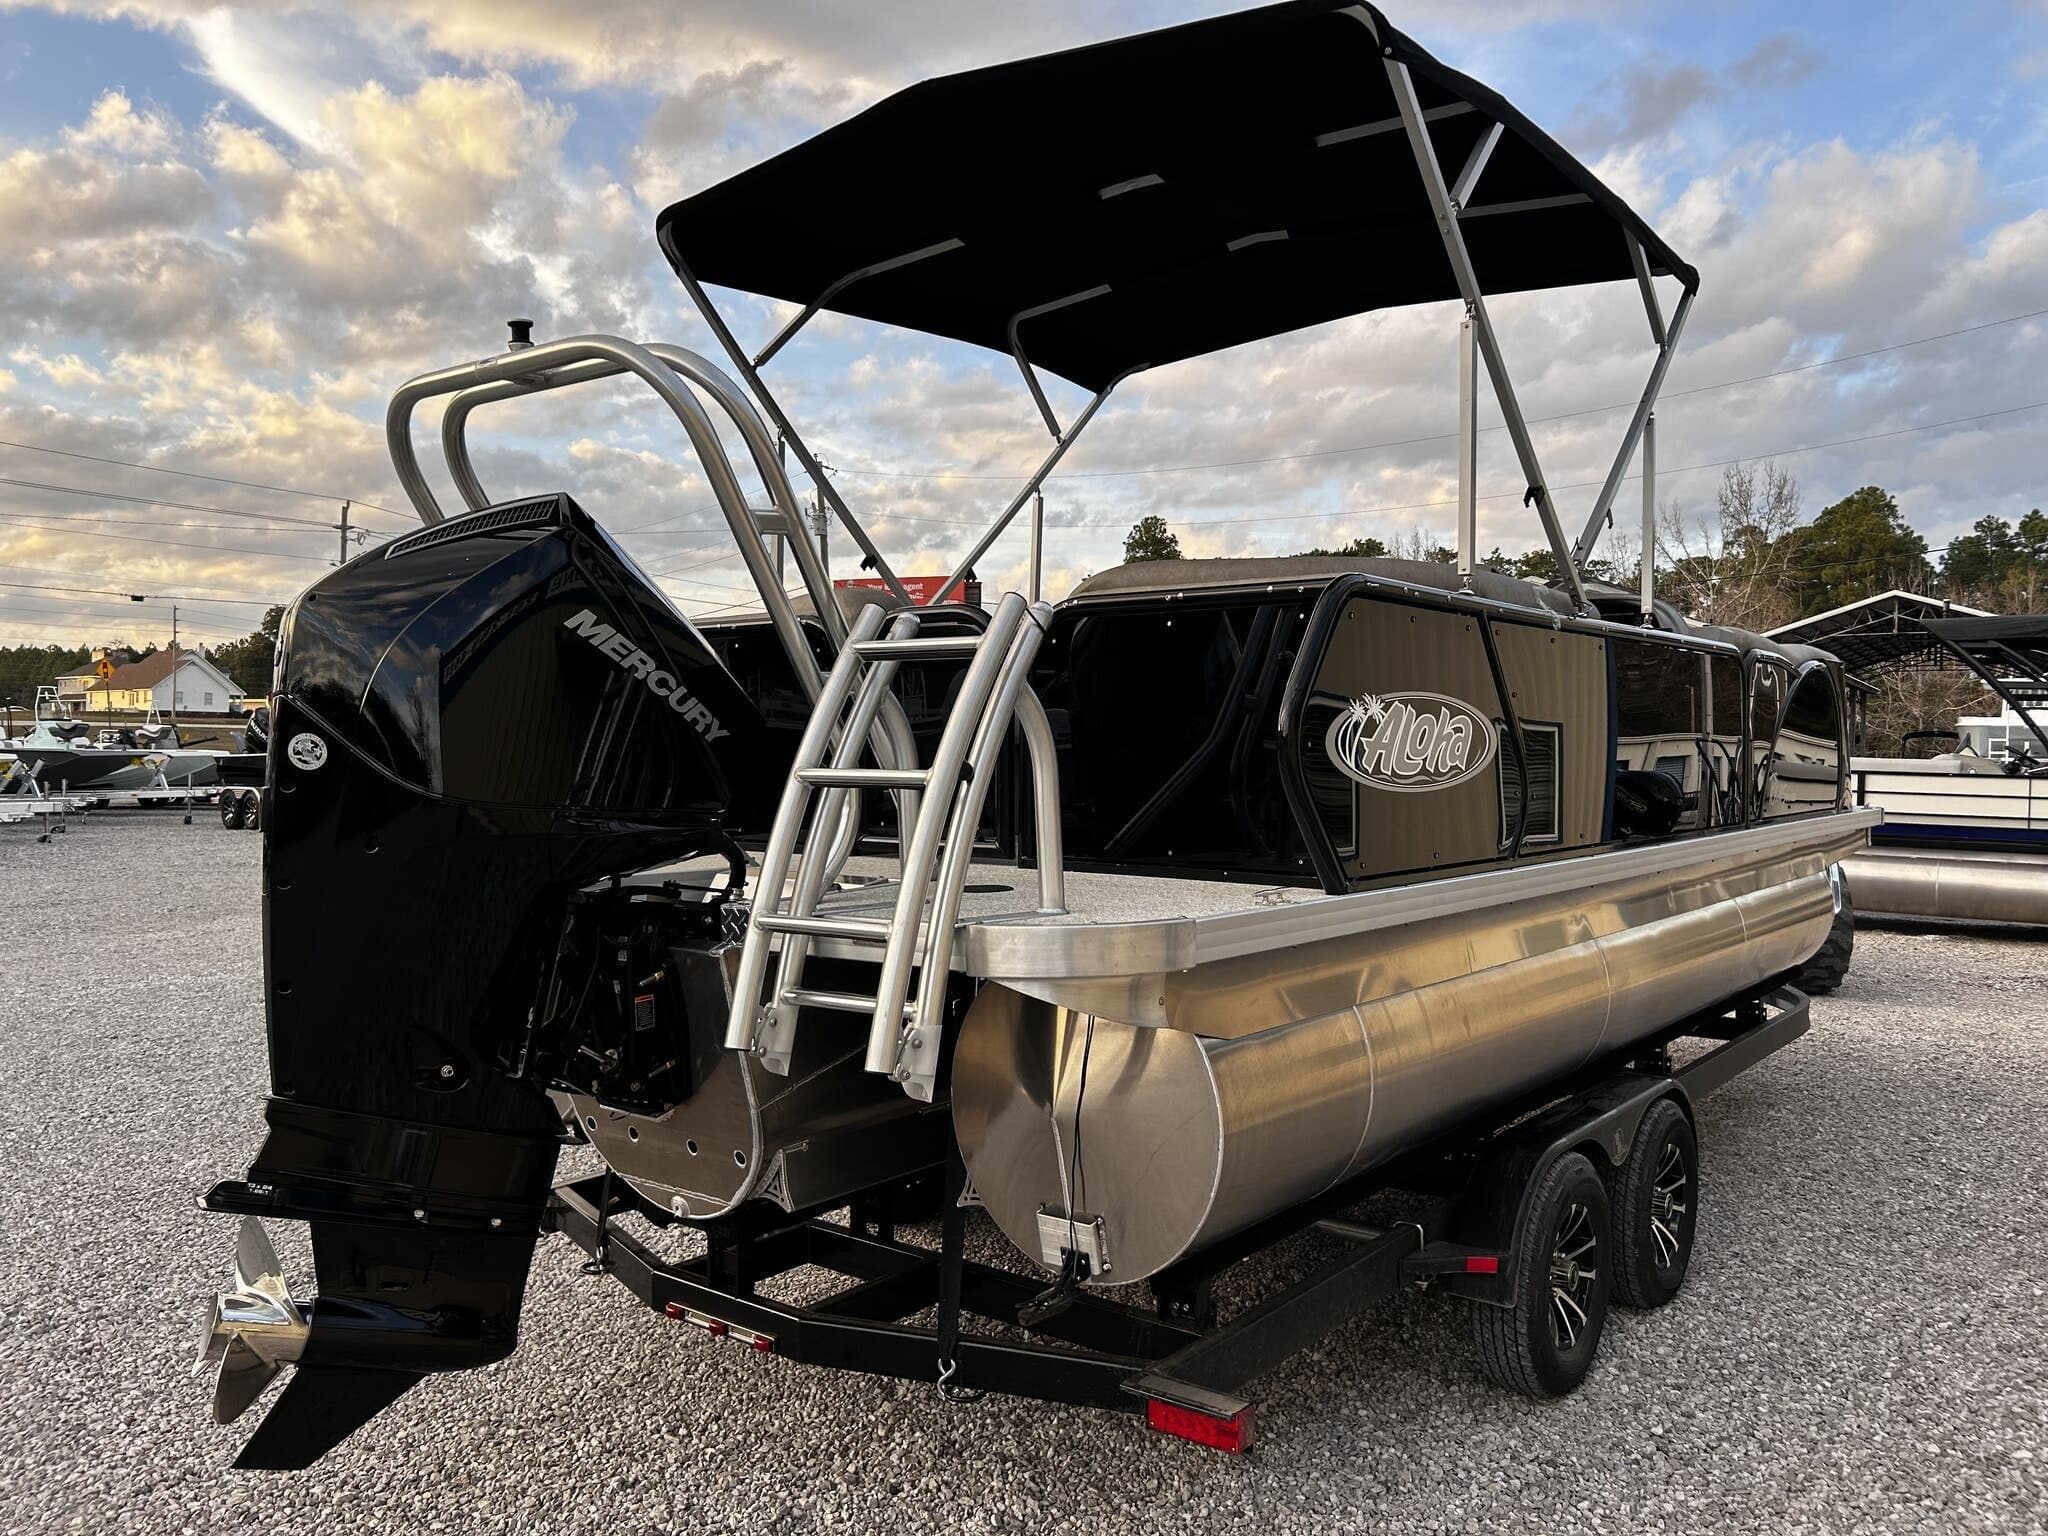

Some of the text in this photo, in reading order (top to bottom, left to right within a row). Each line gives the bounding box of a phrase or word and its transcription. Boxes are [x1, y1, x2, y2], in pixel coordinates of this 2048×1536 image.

[903, 582, 923, 592] agent
[563, 609, 730, 742] MERCURY
[251, 719, 268, 740] SUZUK
